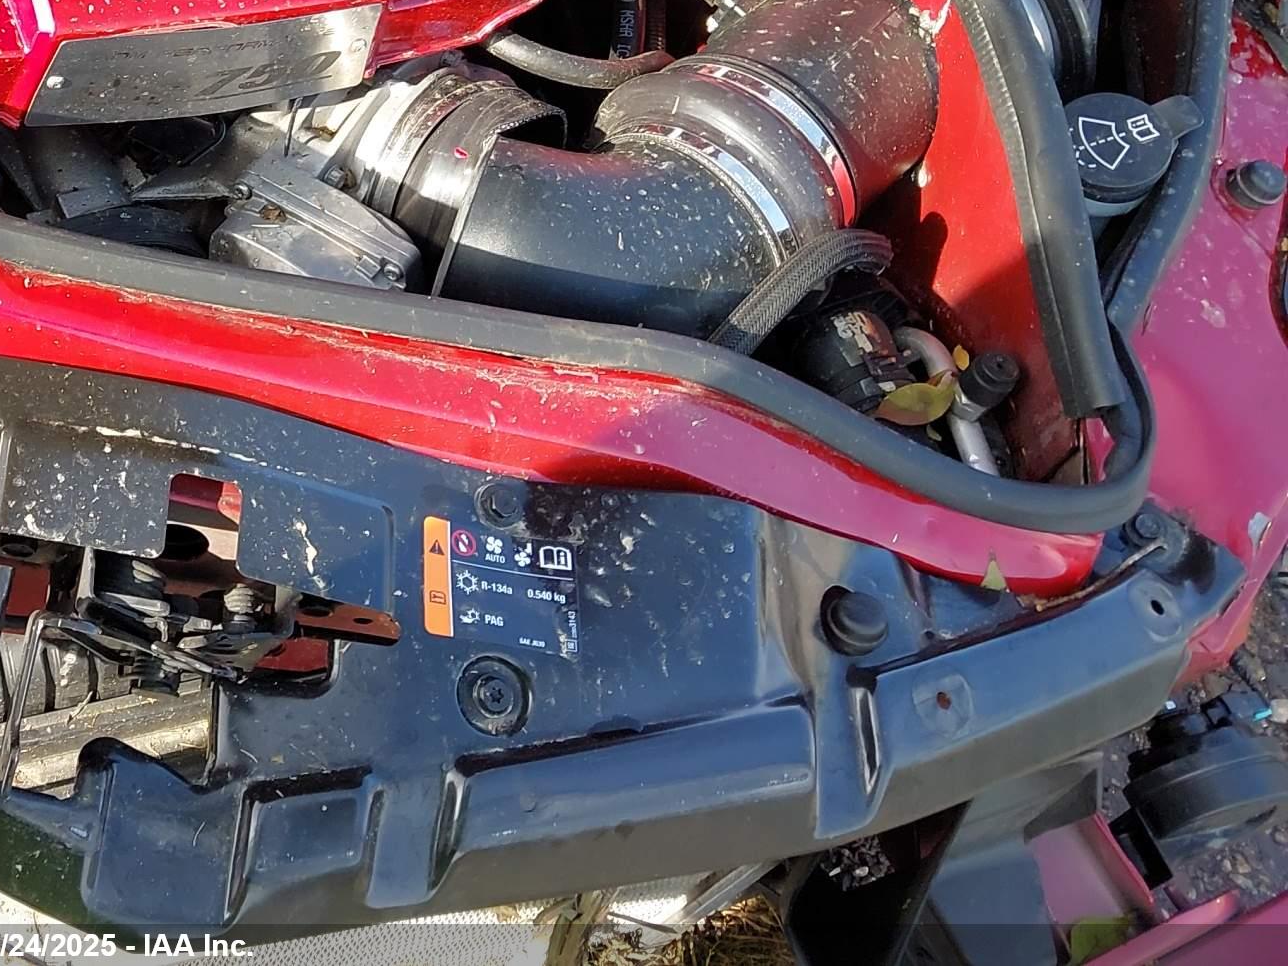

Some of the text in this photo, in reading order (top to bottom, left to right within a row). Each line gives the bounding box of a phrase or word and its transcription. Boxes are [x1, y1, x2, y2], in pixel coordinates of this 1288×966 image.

[485, 552, 506, 565] AUTO
[481, 581, 566, 604] R-134a 0.540 kg
[485, 614, 504, 627] PAG
